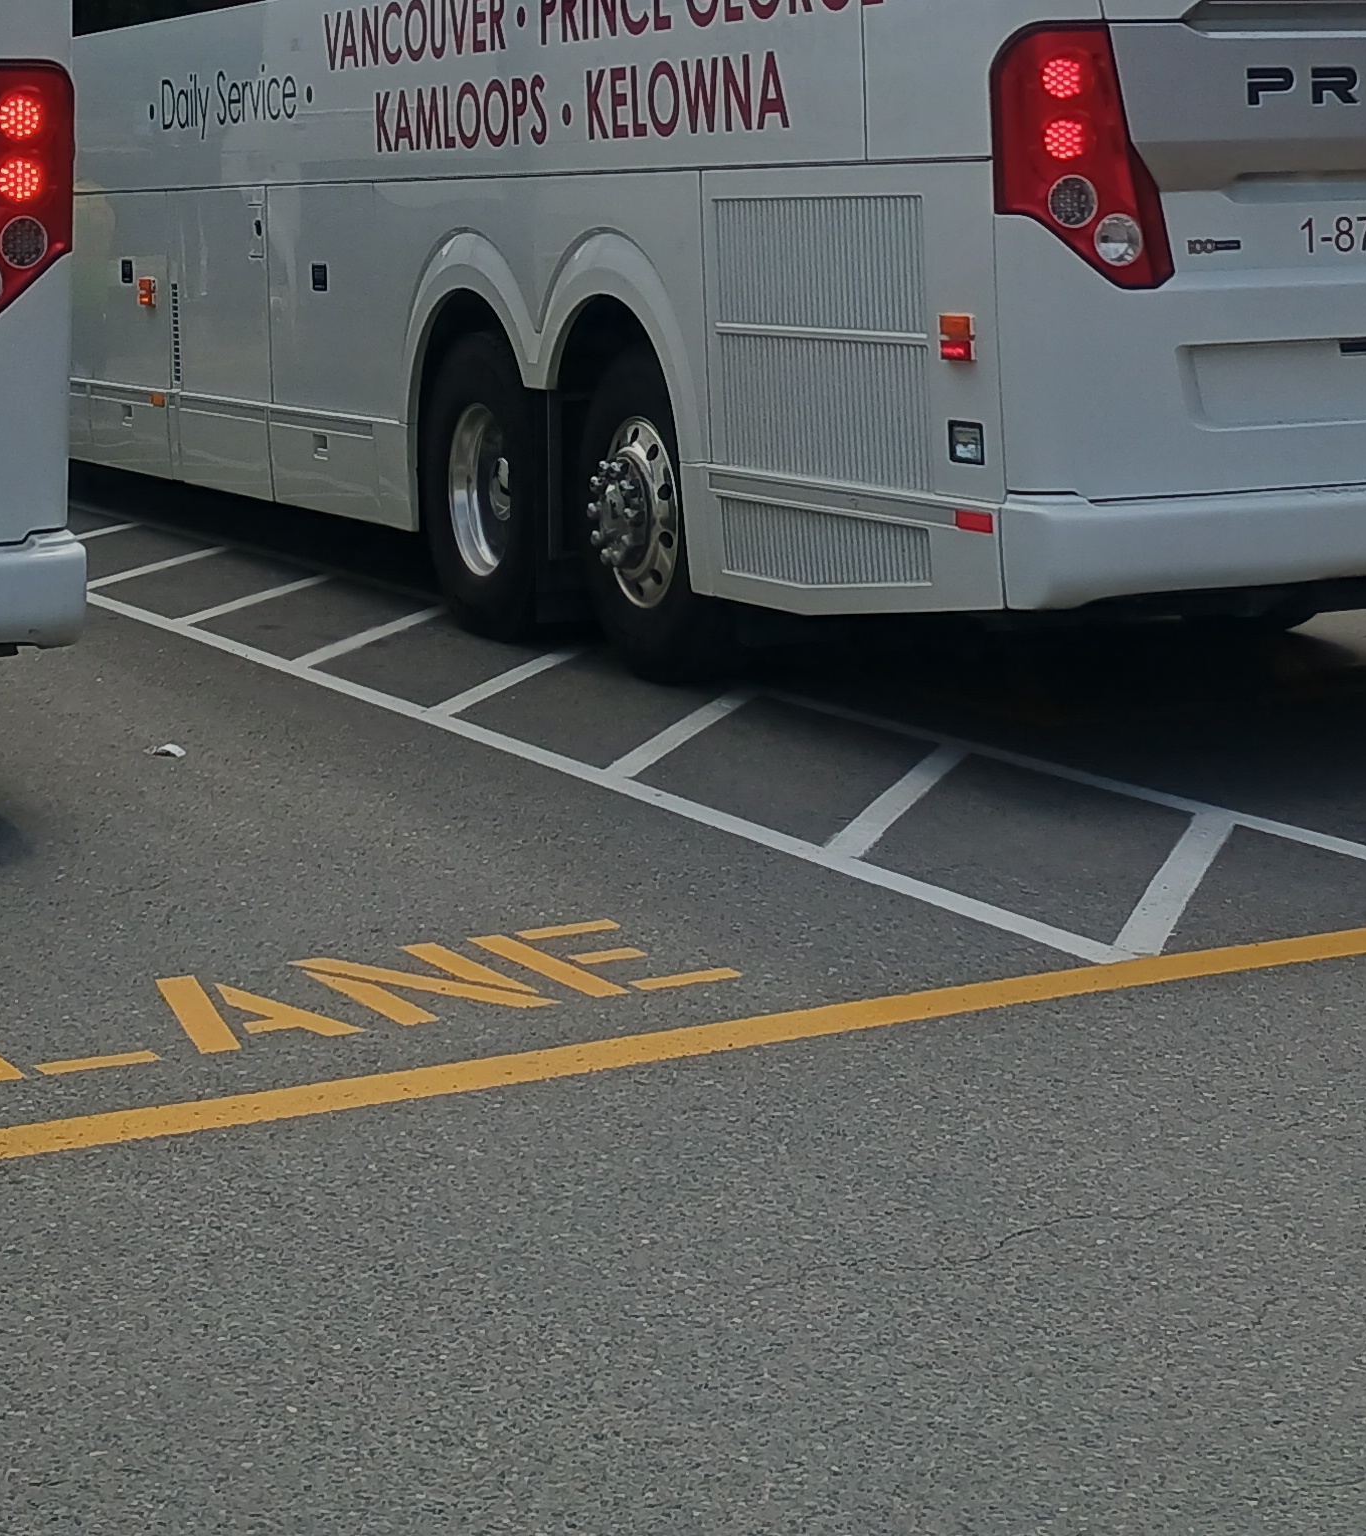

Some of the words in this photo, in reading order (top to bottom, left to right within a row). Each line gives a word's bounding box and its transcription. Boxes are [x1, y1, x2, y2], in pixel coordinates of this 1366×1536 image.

[161, 77, 210, 140] Daily
[216, 66, 297, 126] Service
[375, 74, 547, 153] KAMLOOPS
[585, 50, 790, 141] KELOWNA
